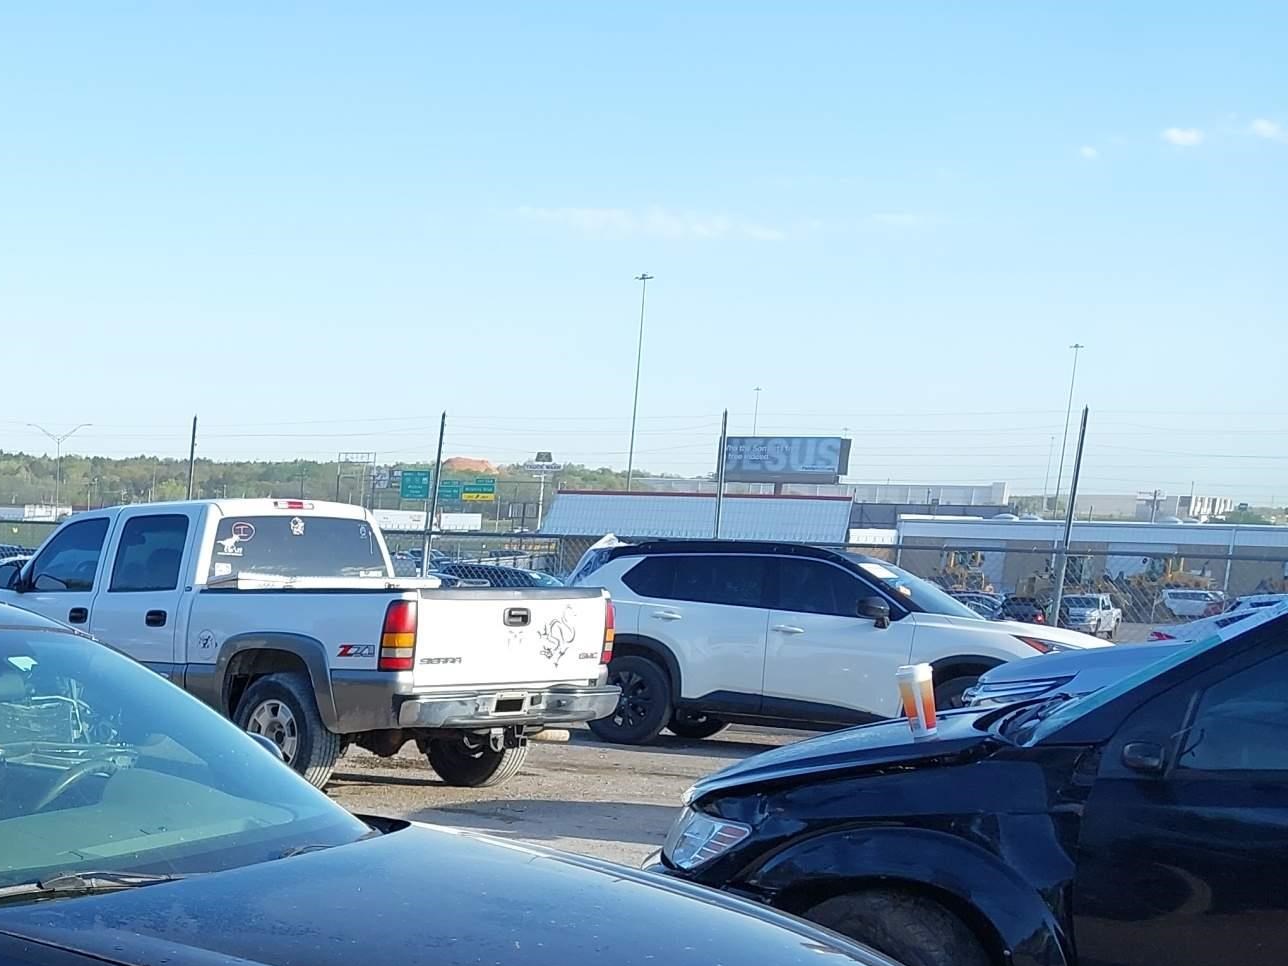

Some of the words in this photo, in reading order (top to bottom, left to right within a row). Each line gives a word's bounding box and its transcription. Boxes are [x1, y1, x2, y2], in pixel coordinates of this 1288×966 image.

[726, 437, 838, 472] JESUS
[336, 644, 375, 658] Z71
[577, 652, 599, 660] GMC
[418, 656, 462, 665] SIERRA
